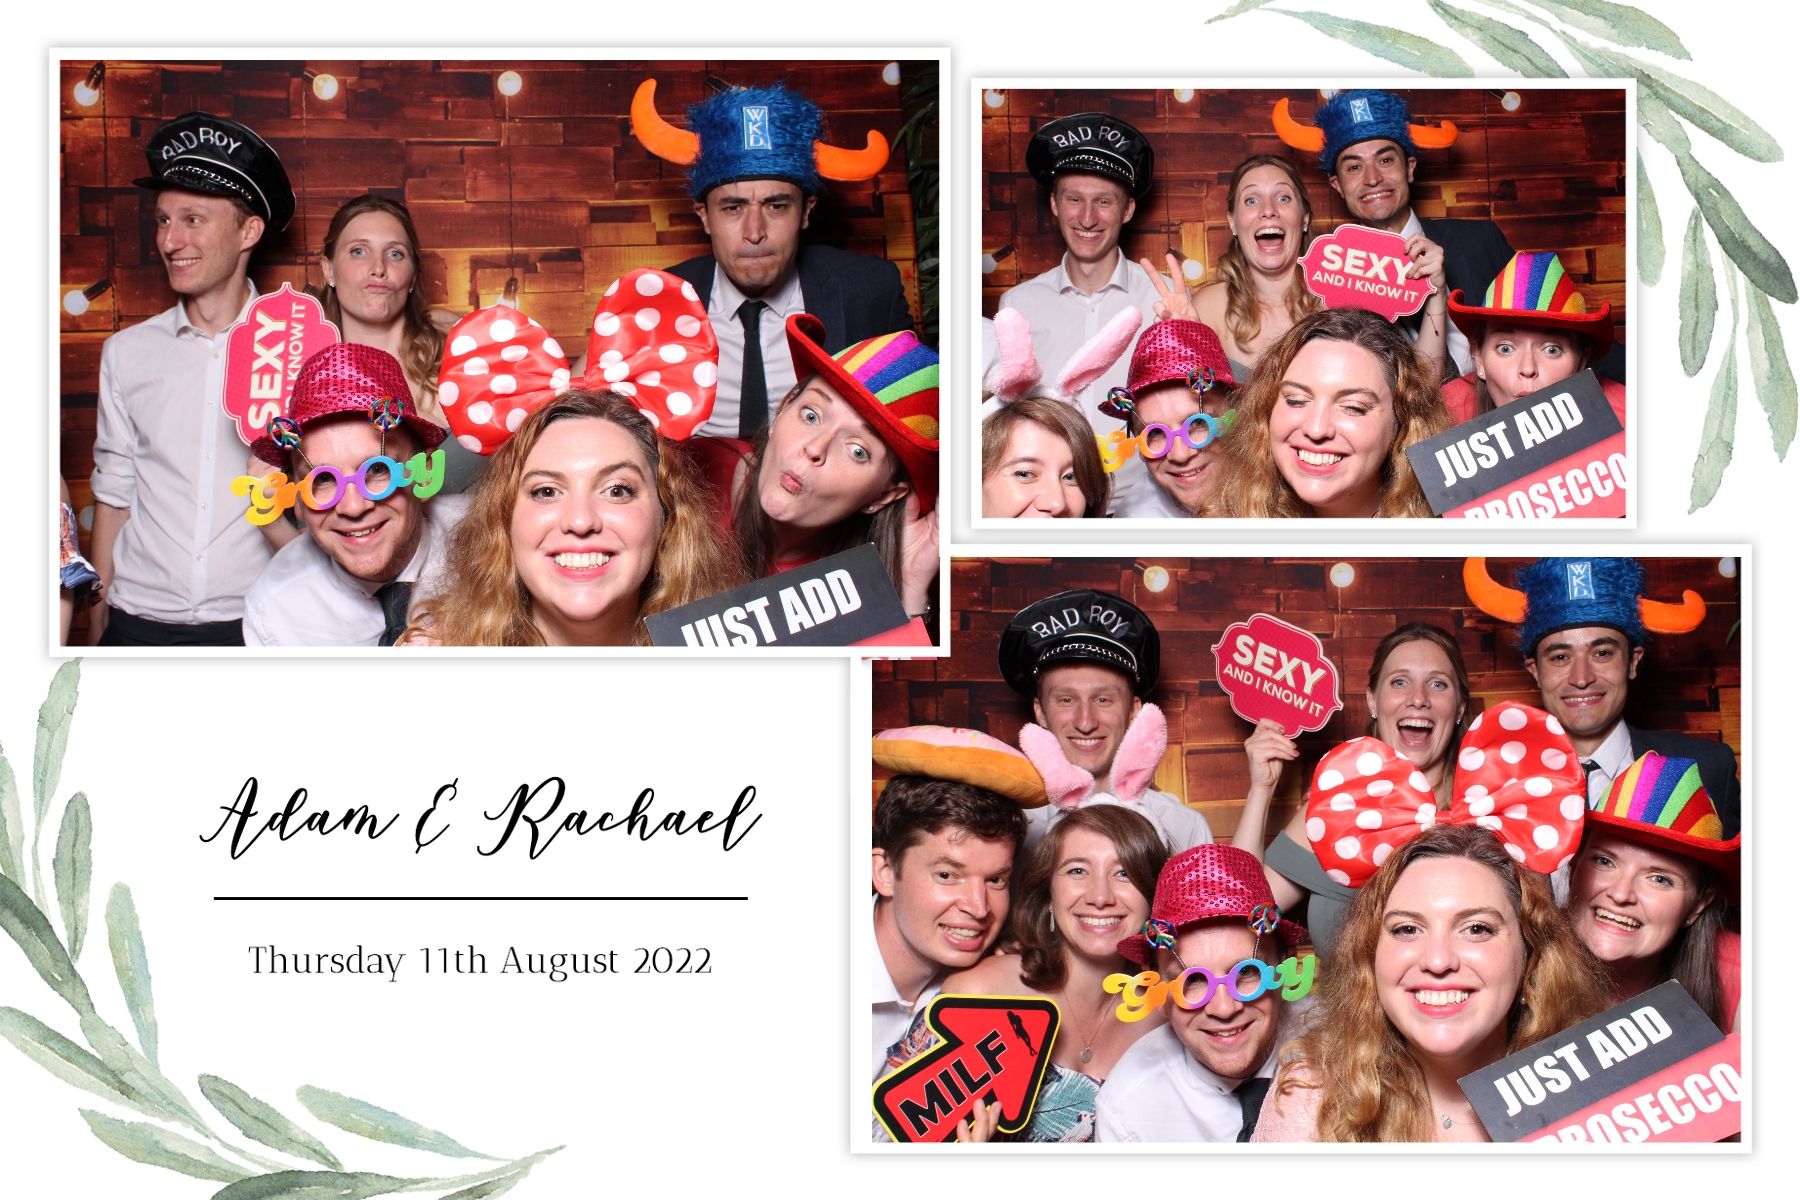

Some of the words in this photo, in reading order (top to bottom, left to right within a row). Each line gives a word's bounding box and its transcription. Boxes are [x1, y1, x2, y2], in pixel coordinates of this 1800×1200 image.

[746, 109, 764, 147] WKD
[1052, 126, 1092, 148] BAD
[1311, 271, 1345, 287] AND
[1347, 278, 1353, 289] I
[1354, 280, 1402, 300] KNOW
[1403, 290, 1419, 303] IT
[1320, 244, 1415, 286] SEXY
[291, 302, 306, 318] IT
[248, 309, 287, 429] SEXY
[286, 322, 305, 380] KNOW
[1434, 421, 1515, 488] JUST
[1513, 392, 1584, 450] ADD
[1464, 452, 1626, 518] OSECCO
[778, 568, 862, 635] ADD
[1031, 607, 1080, 639] BAD
[1223, 663, 1255, 685] AND
[1255, 676, 1262, 689] I
[1262, 680, 1309, 710] KNOW
[1308, 701, 1325, 717] IT
[1232, 634, 1328, 697] SEXY
[898, 1029, 1008, 1137] MILF
[1494, 1042, 1591, 1118] JUST
[1585, 1005, 1673, 1070] ADD
[1532, 1063, 1741, 1142] OSECCO
